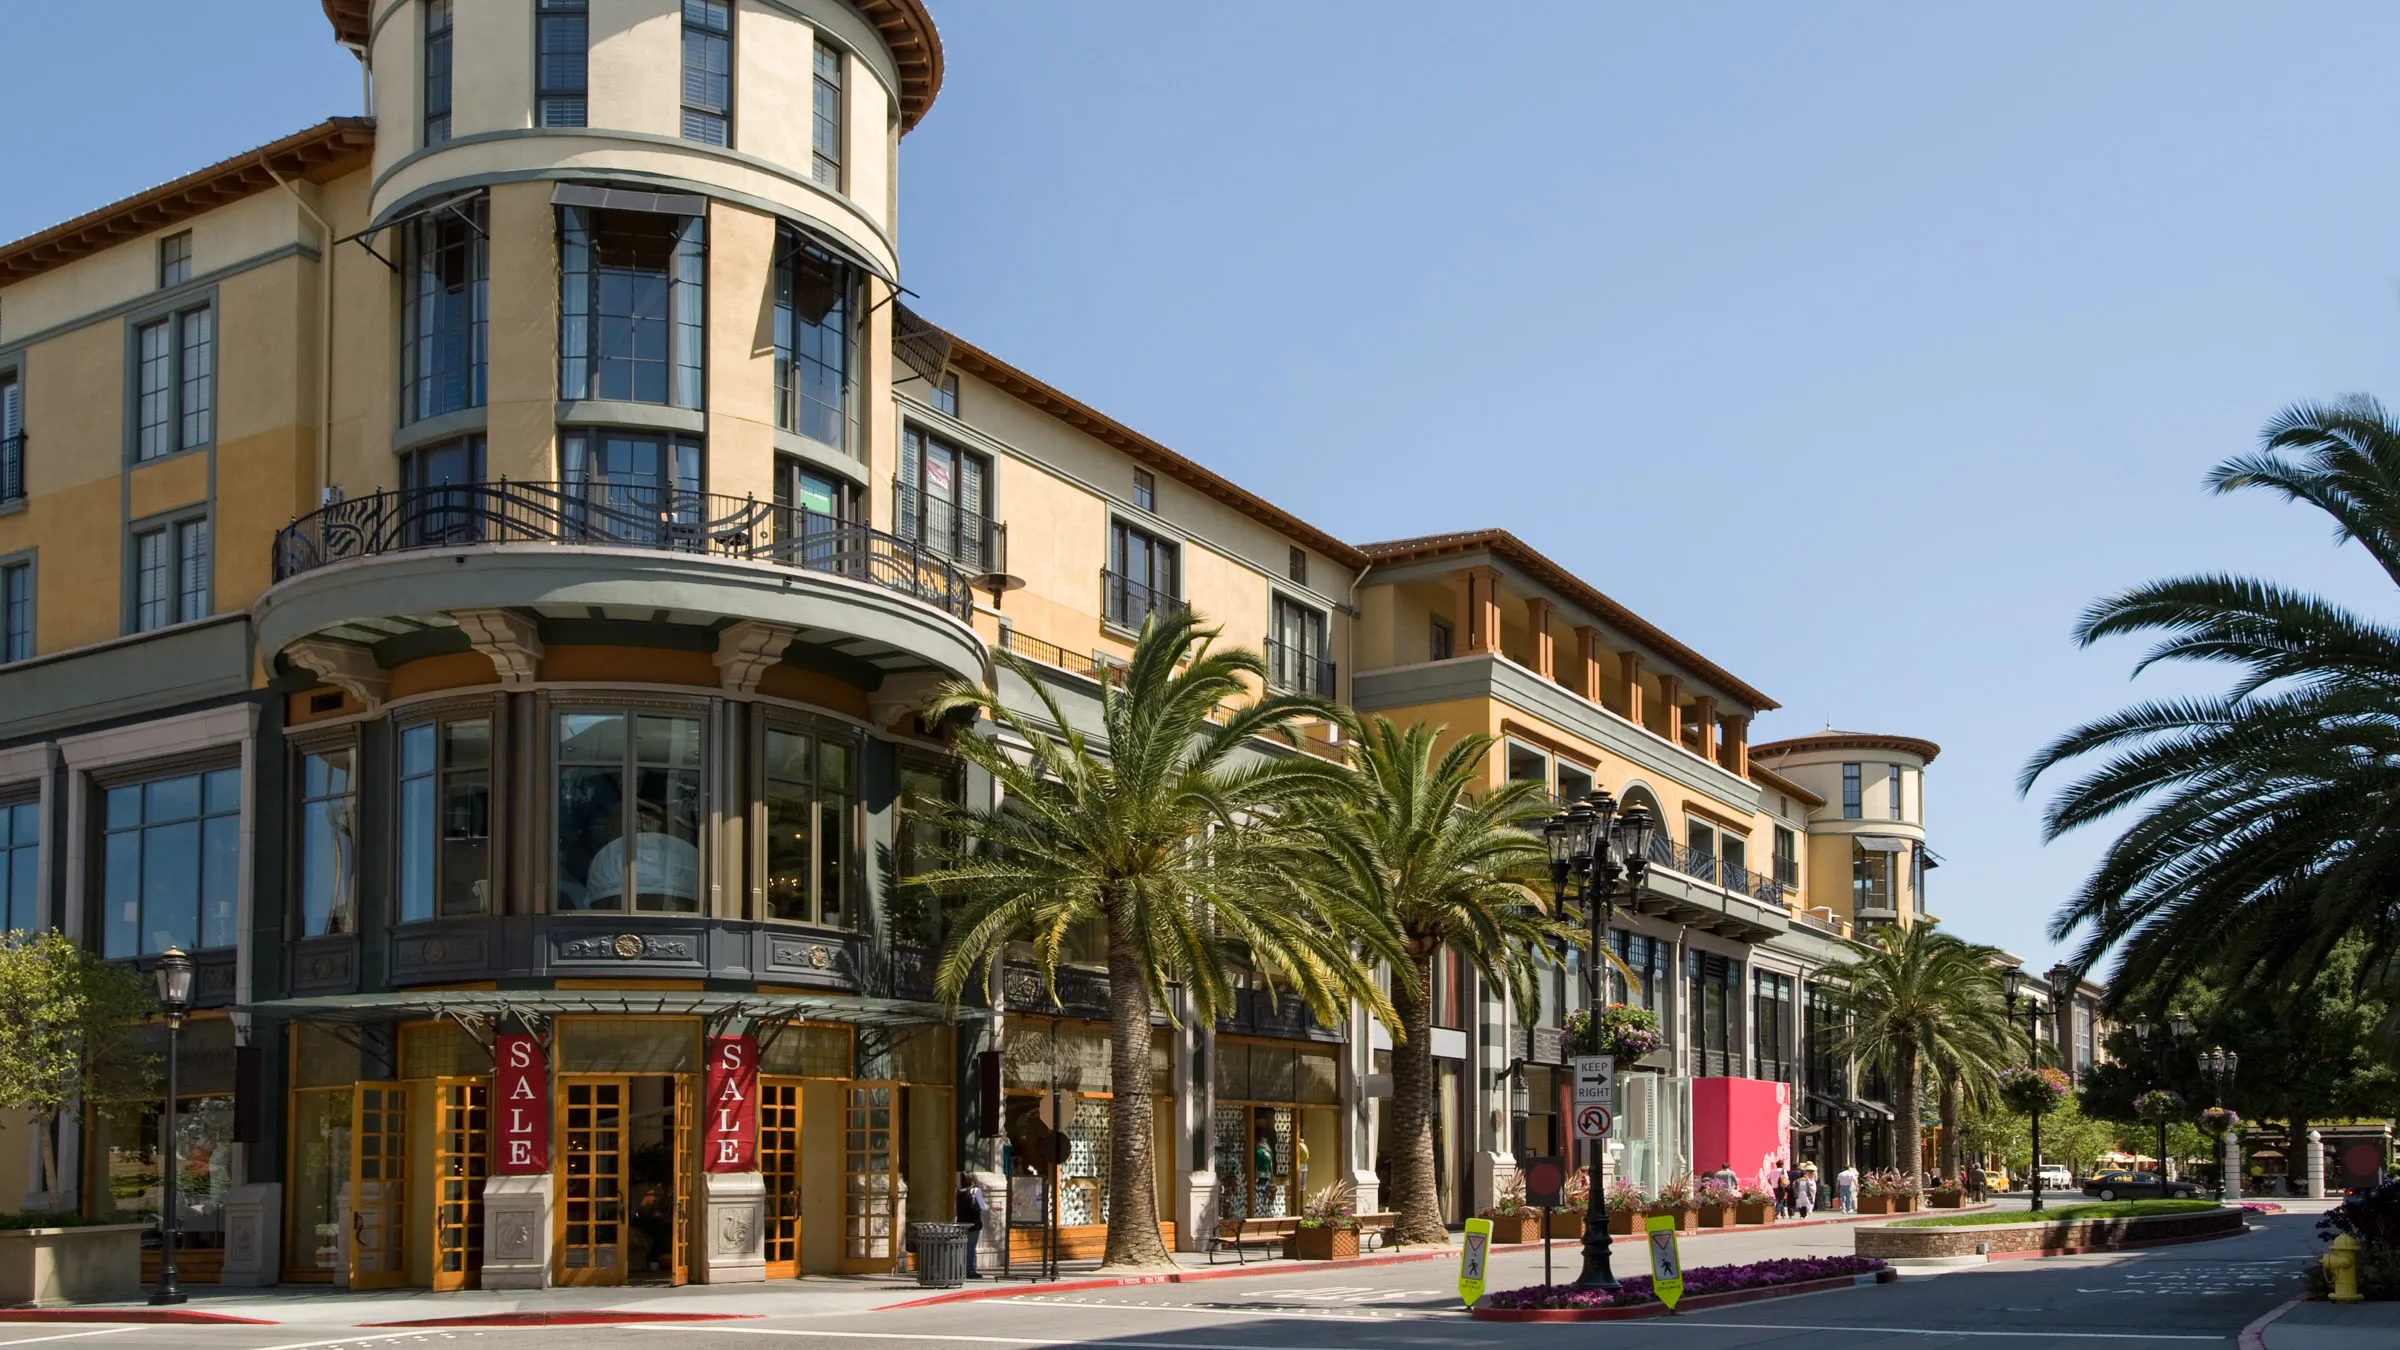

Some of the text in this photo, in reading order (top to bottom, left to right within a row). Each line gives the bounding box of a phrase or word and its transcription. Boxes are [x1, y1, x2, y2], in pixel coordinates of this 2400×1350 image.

[1578, 1087, 1610, 1097] RIGHT
[1581, 1062, 1608, 1072] KEEP
[508, 1041, 536, 1165] SALE
[717, 1044, 744, 1163] SALE
